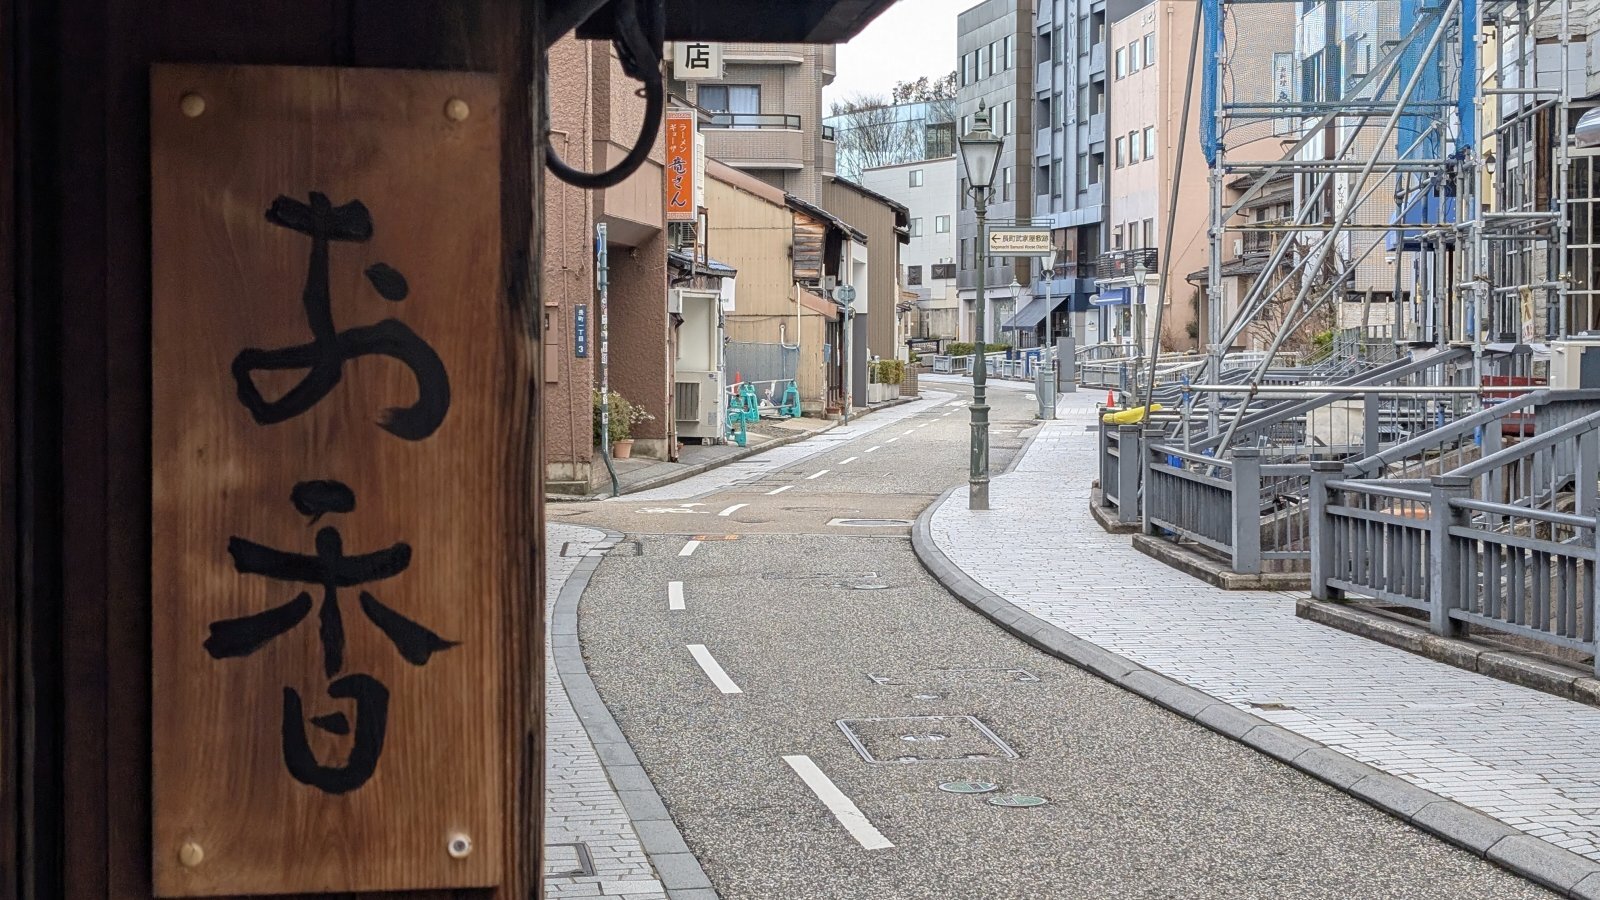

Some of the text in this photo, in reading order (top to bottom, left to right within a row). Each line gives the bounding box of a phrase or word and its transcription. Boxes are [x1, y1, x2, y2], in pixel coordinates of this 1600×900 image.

[685, 43, 709, 69] 店
[578, 345, 584, 353] 3
[203, 191, 463, 794] お香
